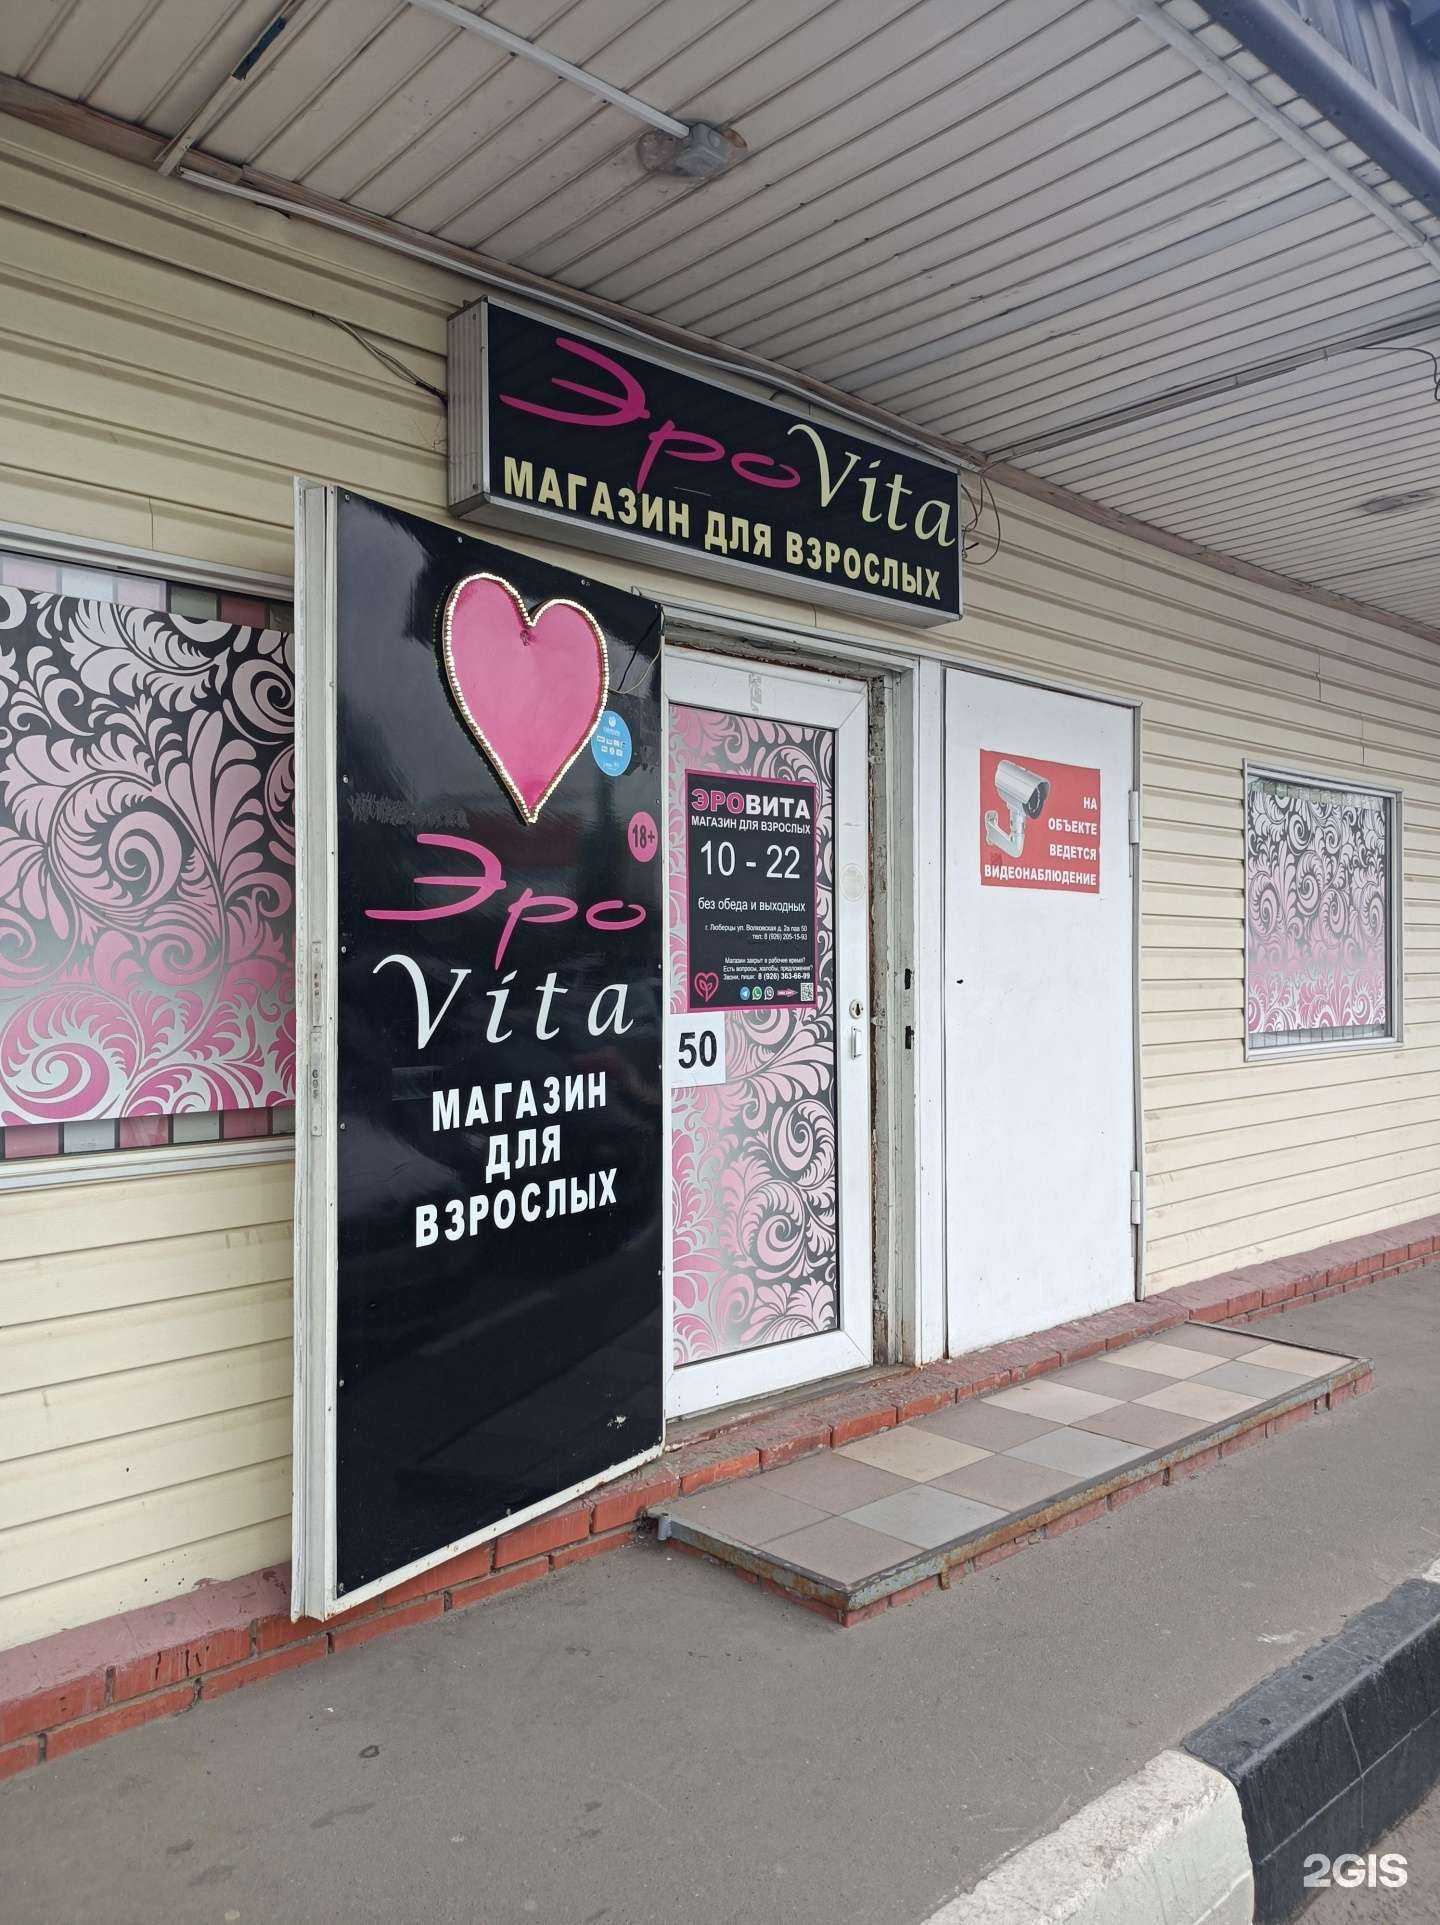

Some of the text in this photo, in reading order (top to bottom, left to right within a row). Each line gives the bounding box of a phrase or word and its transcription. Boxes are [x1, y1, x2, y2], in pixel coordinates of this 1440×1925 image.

[504, 456, 941, 600] МАГАЗИН ДЛЯ ВЗРОСЛЫХ
[691, 788, 811, 820] ЭРОВИТА
[1083, 796, 1098, 810] НА
[632, 823, 656, 849] 18+
[691, 815, 811, 835] МАГАЗИН ДЛЯ ВЗРОСЛЫХ
[1048, 817, 1098, 835] ОБЪЕКТЕ
[700, 840, 736, 877] 10
[766, 844, 800, 879] 22
[1049, 843, 1097, 861] ВЕДЕТСЯ
[984, 864, 1097, 886] ВИДЕОНАБЛЮДЕНИЕ
[364, 833, 646, 970] Эро
[698, 897, 806, 914] без обеда и выходных
[372, 954, 634, 1050] Vita
[679, 1030, 717, 1069] 50
[432, 1071, 606, 1132] МАГАЗИН
[485, 1124, 561, 1184] ДЛЯ
[415, 1167, 618, 1248] ВЗРОСЛЫХ
